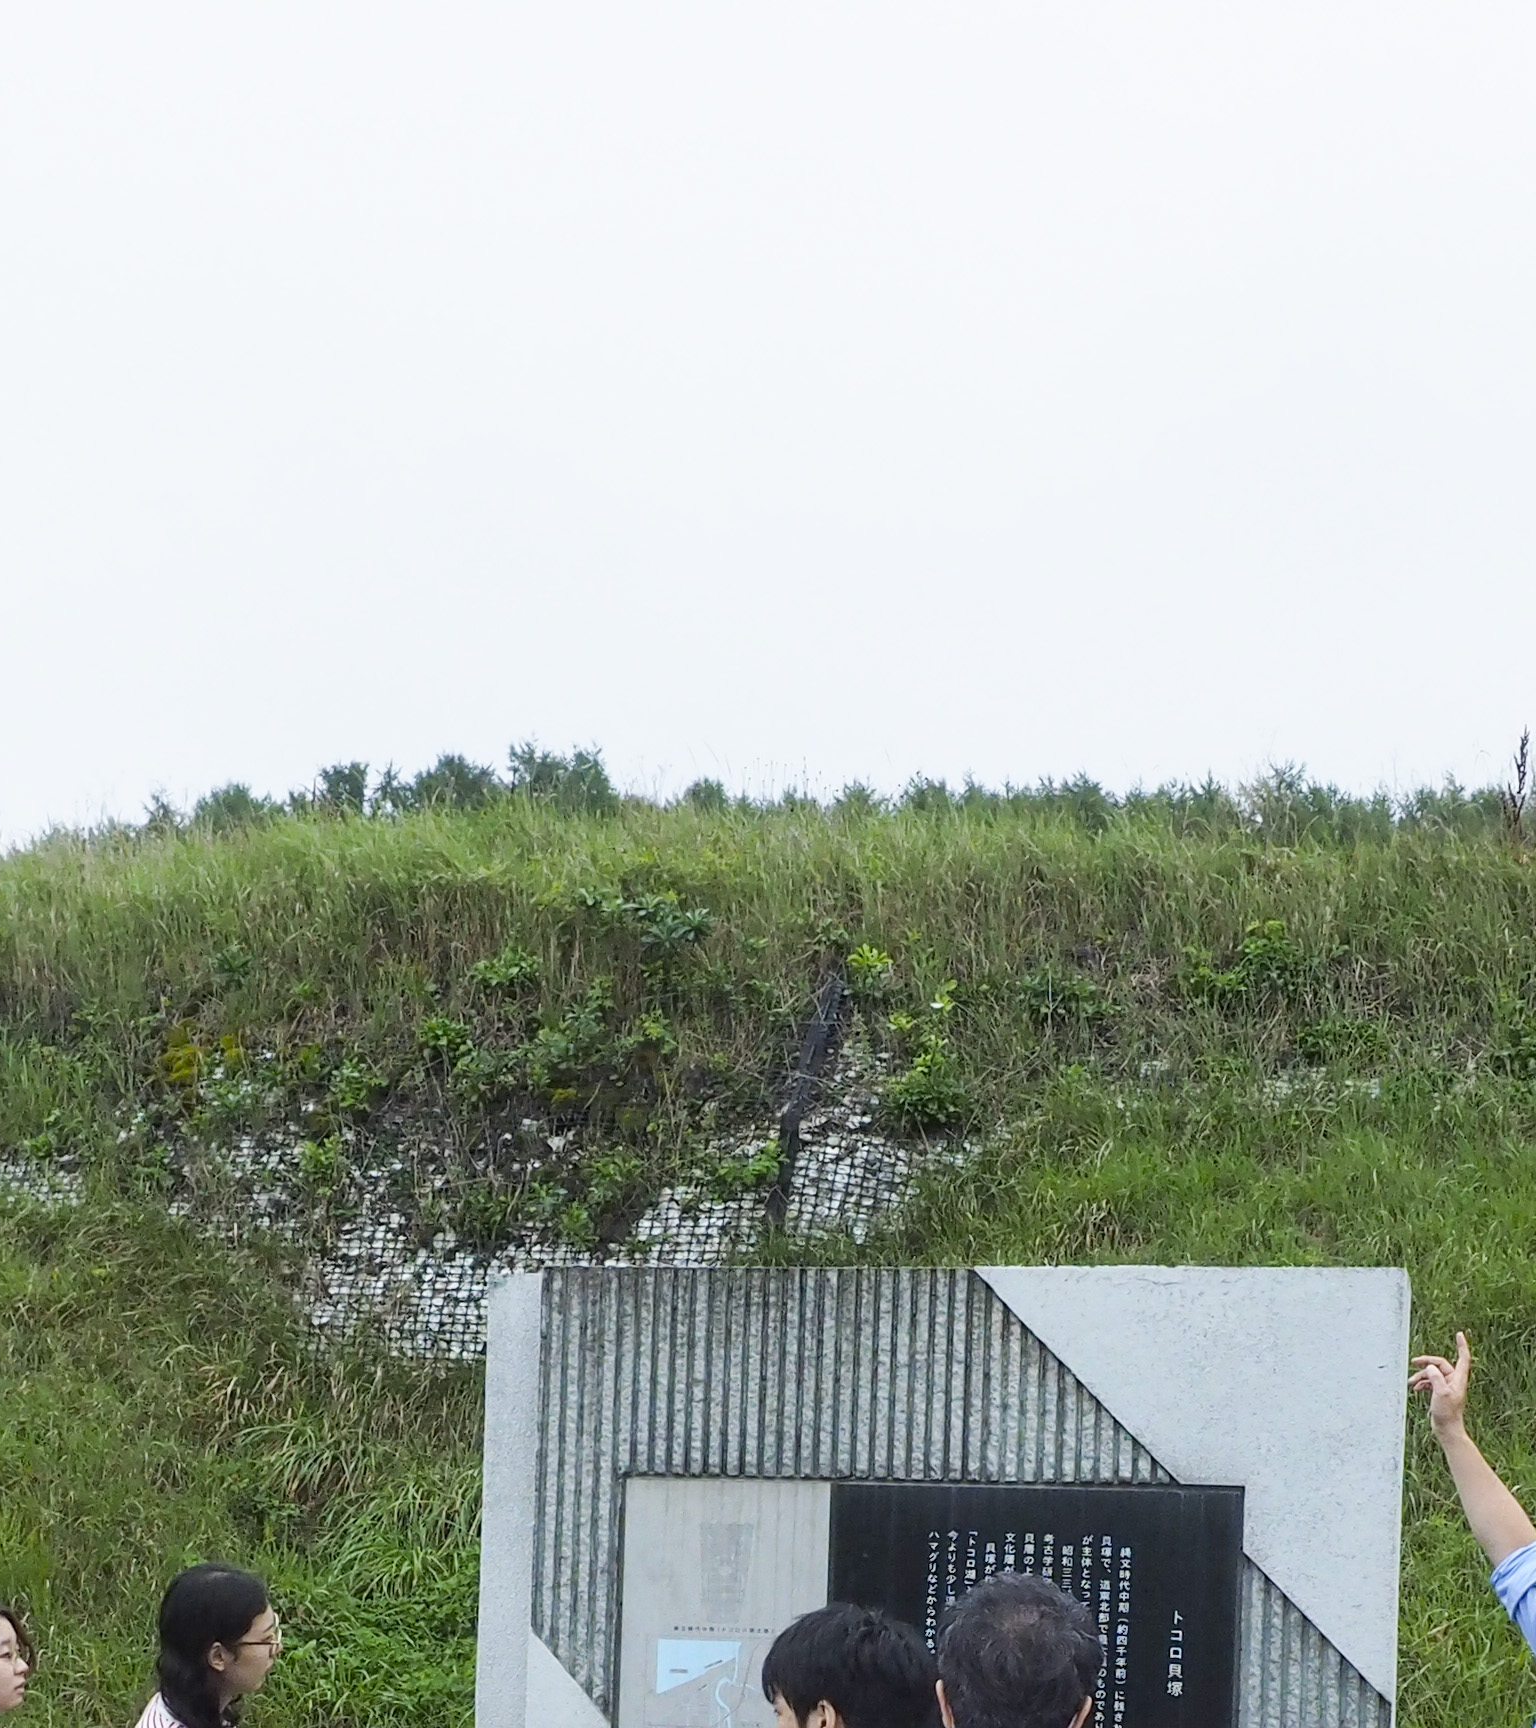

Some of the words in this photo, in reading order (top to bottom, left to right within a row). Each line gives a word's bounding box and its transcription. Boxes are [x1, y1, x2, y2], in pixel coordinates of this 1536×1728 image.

[925, 1531, 941, 1655] ハマグリなどからわかる。
[1166, 1610, 1184, 1698] トコロ貝塚
